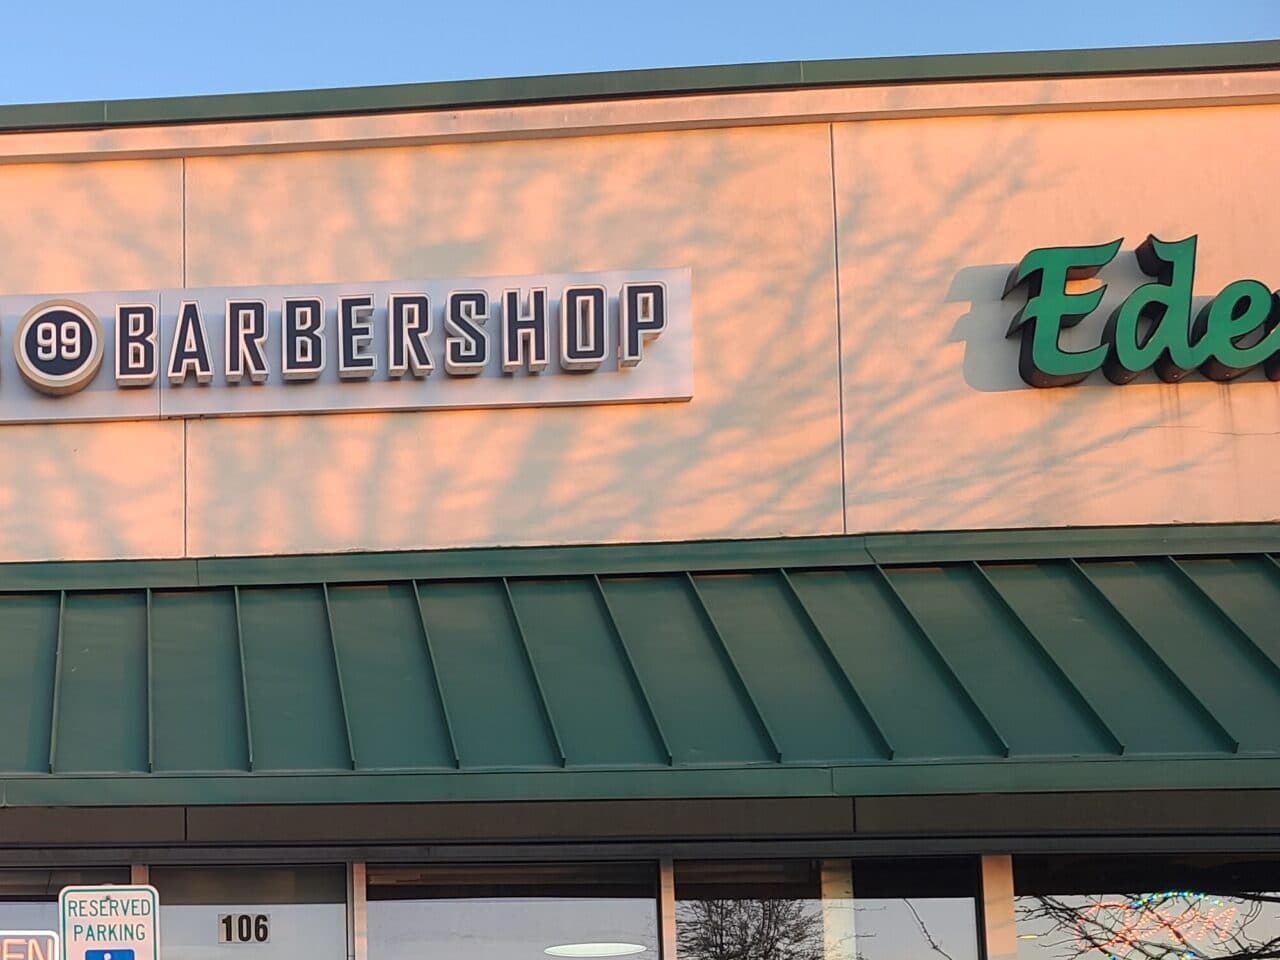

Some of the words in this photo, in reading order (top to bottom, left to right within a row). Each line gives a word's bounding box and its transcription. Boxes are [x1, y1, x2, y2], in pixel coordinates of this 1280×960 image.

[1003, 234, 1280, 387] Ede
[36, 320, 82, 362] 99
[115, 281, 668, 387] BARBERSHOP
[68, 899, 151, 917] RESERVED
[73, 923, 146, 942] PARKING
[221, 914, 269, 942] 106
